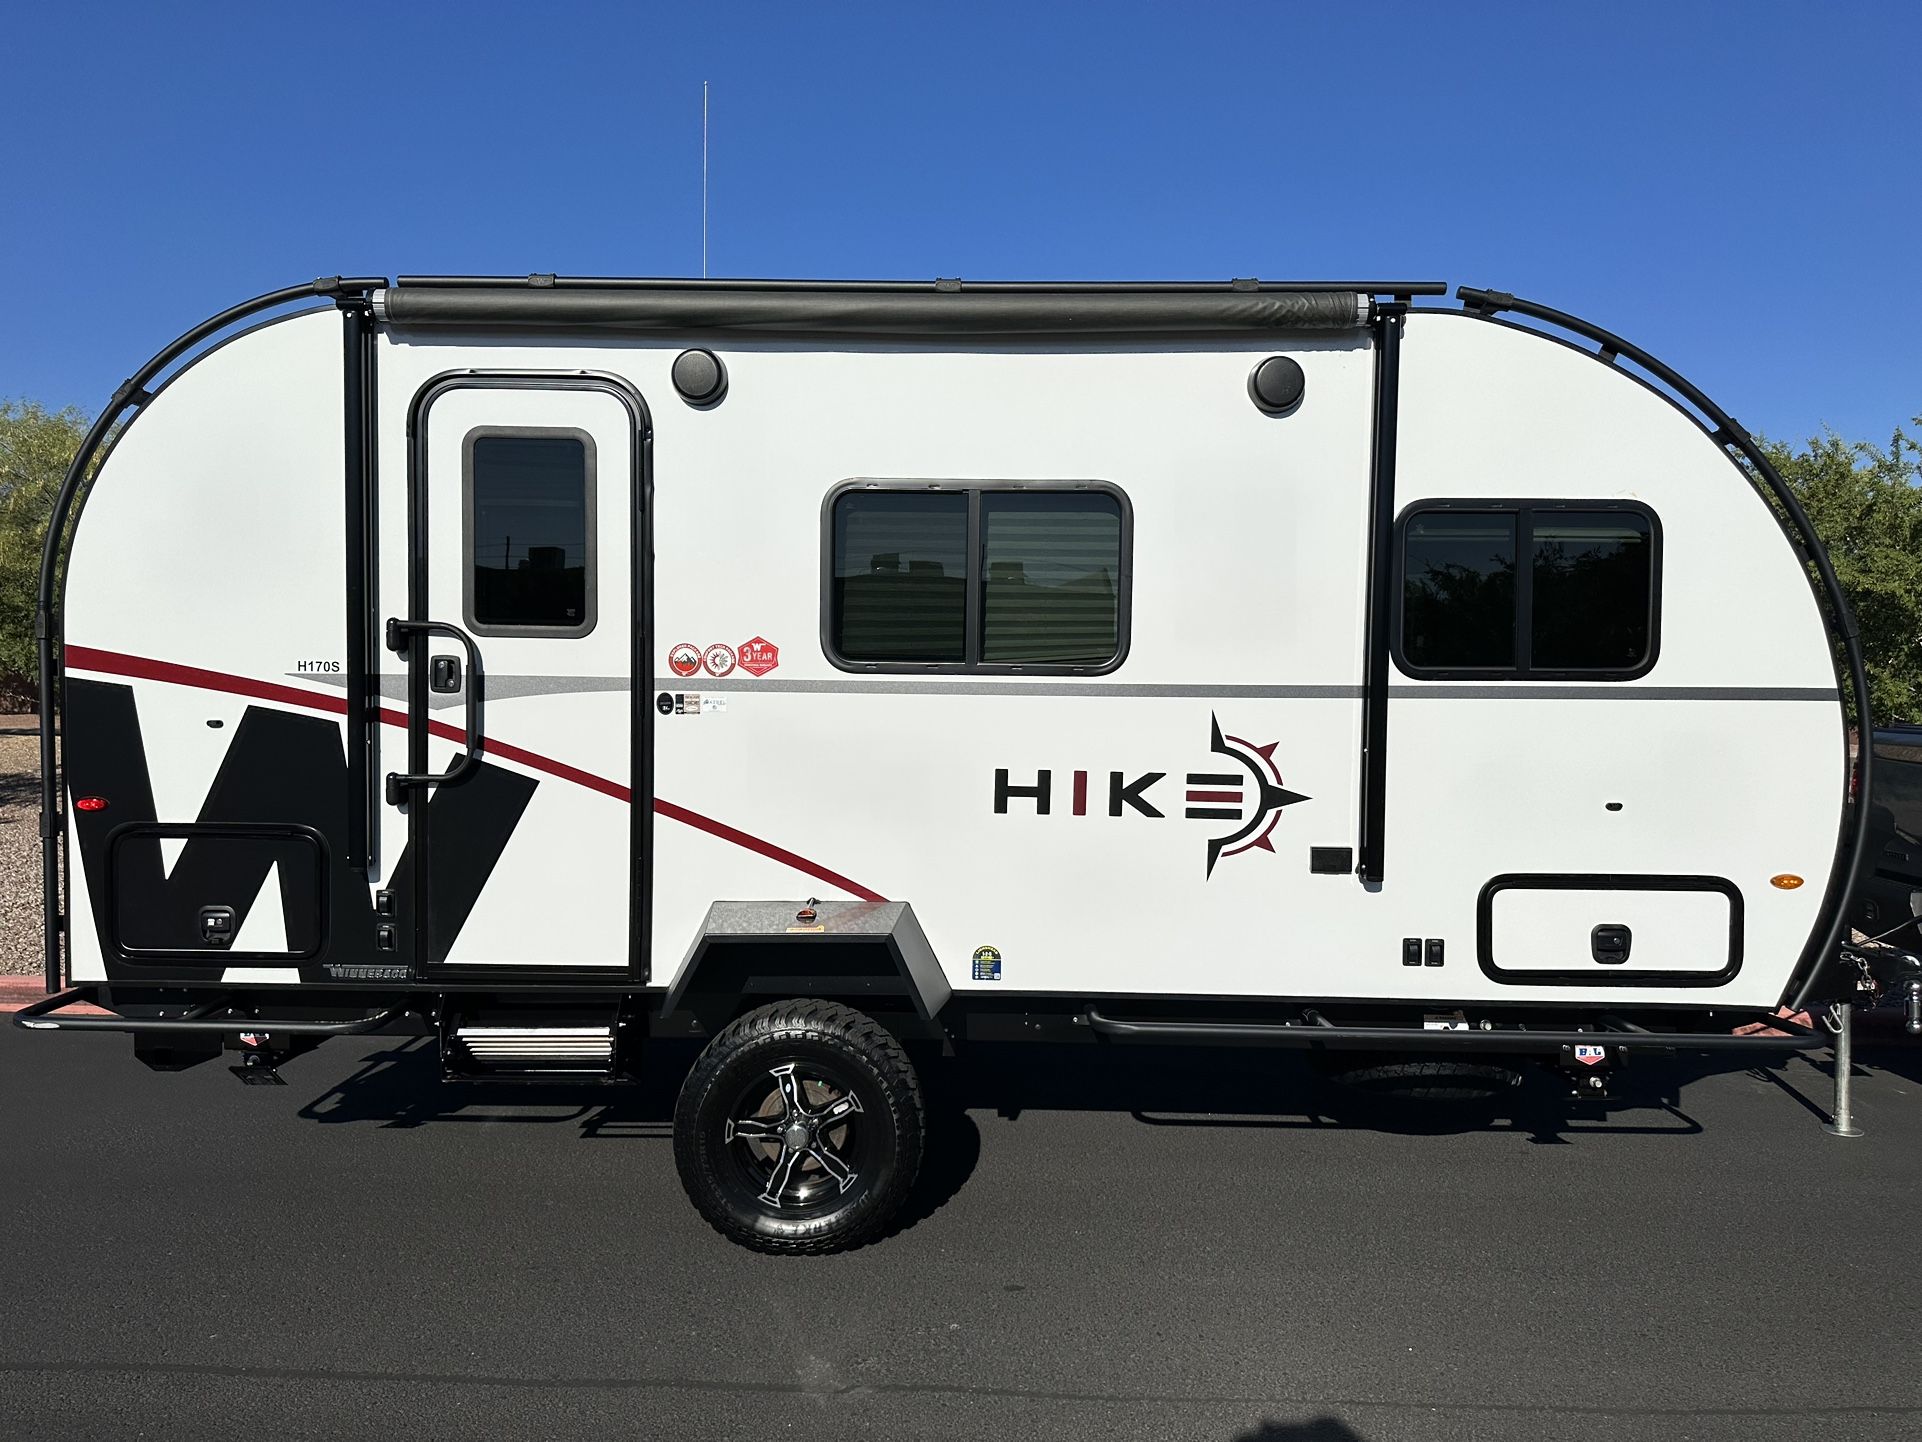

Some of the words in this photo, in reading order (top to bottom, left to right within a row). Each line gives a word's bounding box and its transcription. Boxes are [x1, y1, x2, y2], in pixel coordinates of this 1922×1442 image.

[743, 647, 751, 662] 3
[752, 652, 773, 661] YEAR
[298, 660, 340, 672] H170S
